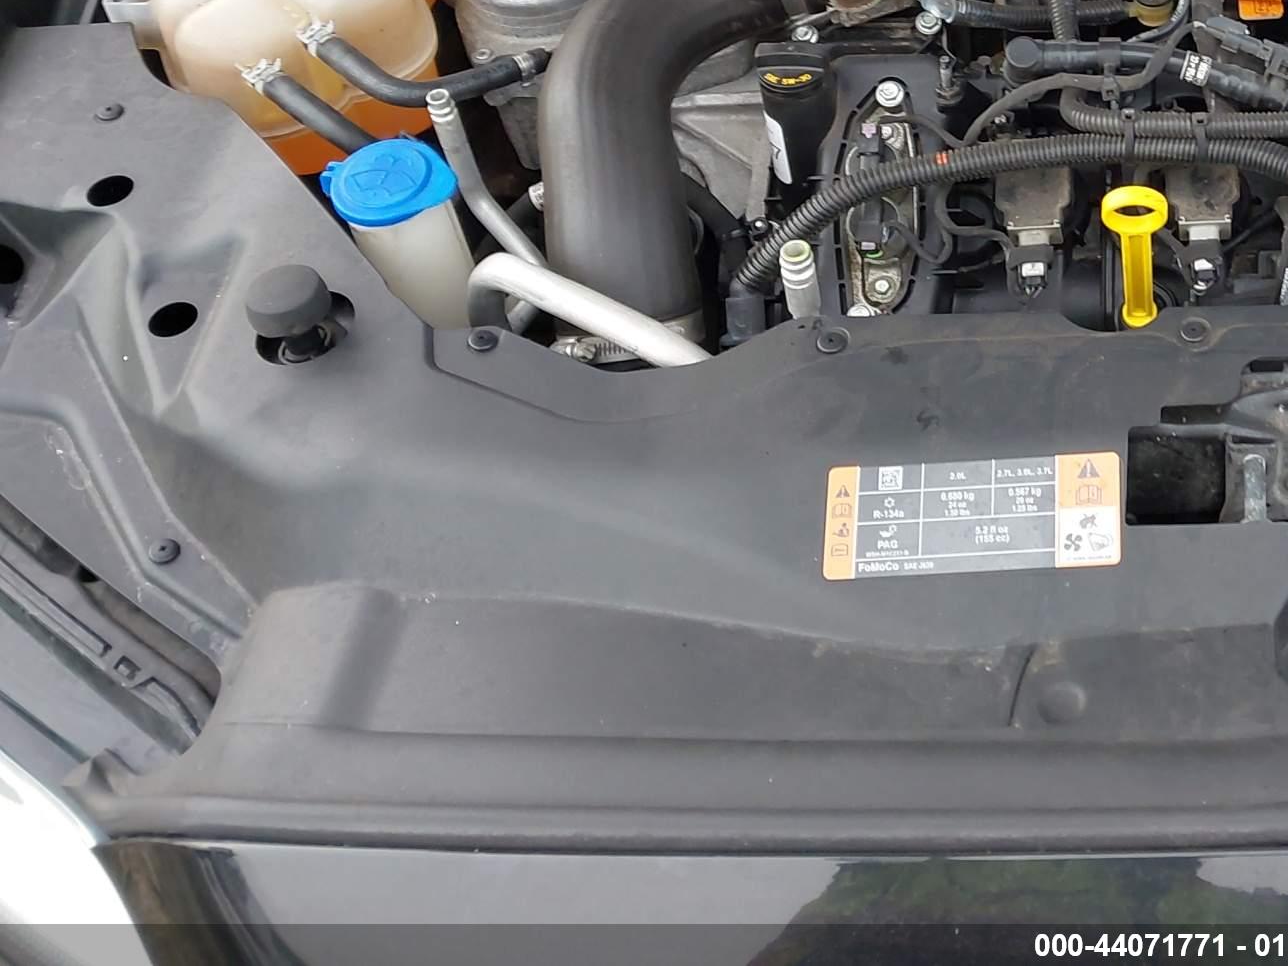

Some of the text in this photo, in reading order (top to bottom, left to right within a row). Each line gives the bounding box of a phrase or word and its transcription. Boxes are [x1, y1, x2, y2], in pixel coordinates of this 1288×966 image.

[764, 73, 812, 85] SAE 5W-30
[872, 509, 905, 519] R-134a
[877, 539, 898, 549] PAG
[858, 562, 899, 573] FoMoCo
